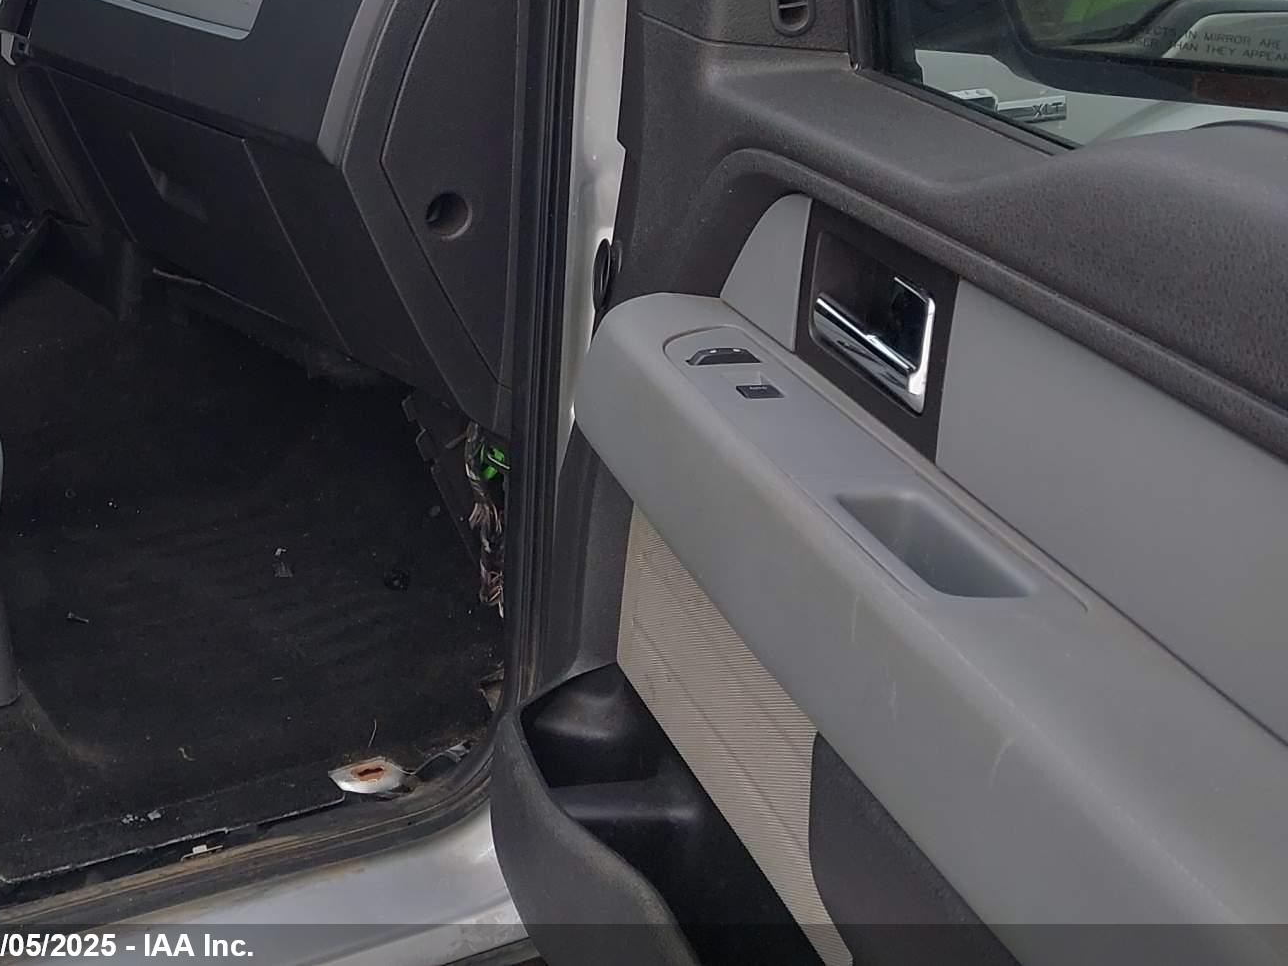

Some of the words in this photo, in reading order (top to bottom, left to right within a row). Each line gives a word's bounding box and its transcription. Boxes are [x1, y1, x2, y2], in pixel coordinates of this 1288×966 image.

[1203, 31, 1251, 46] MIRROR
[1259, 37, 1282, 51] ARE
[1206, 43, 1238, 57] THEY
[1032, 101, 1064, 119] XLT
